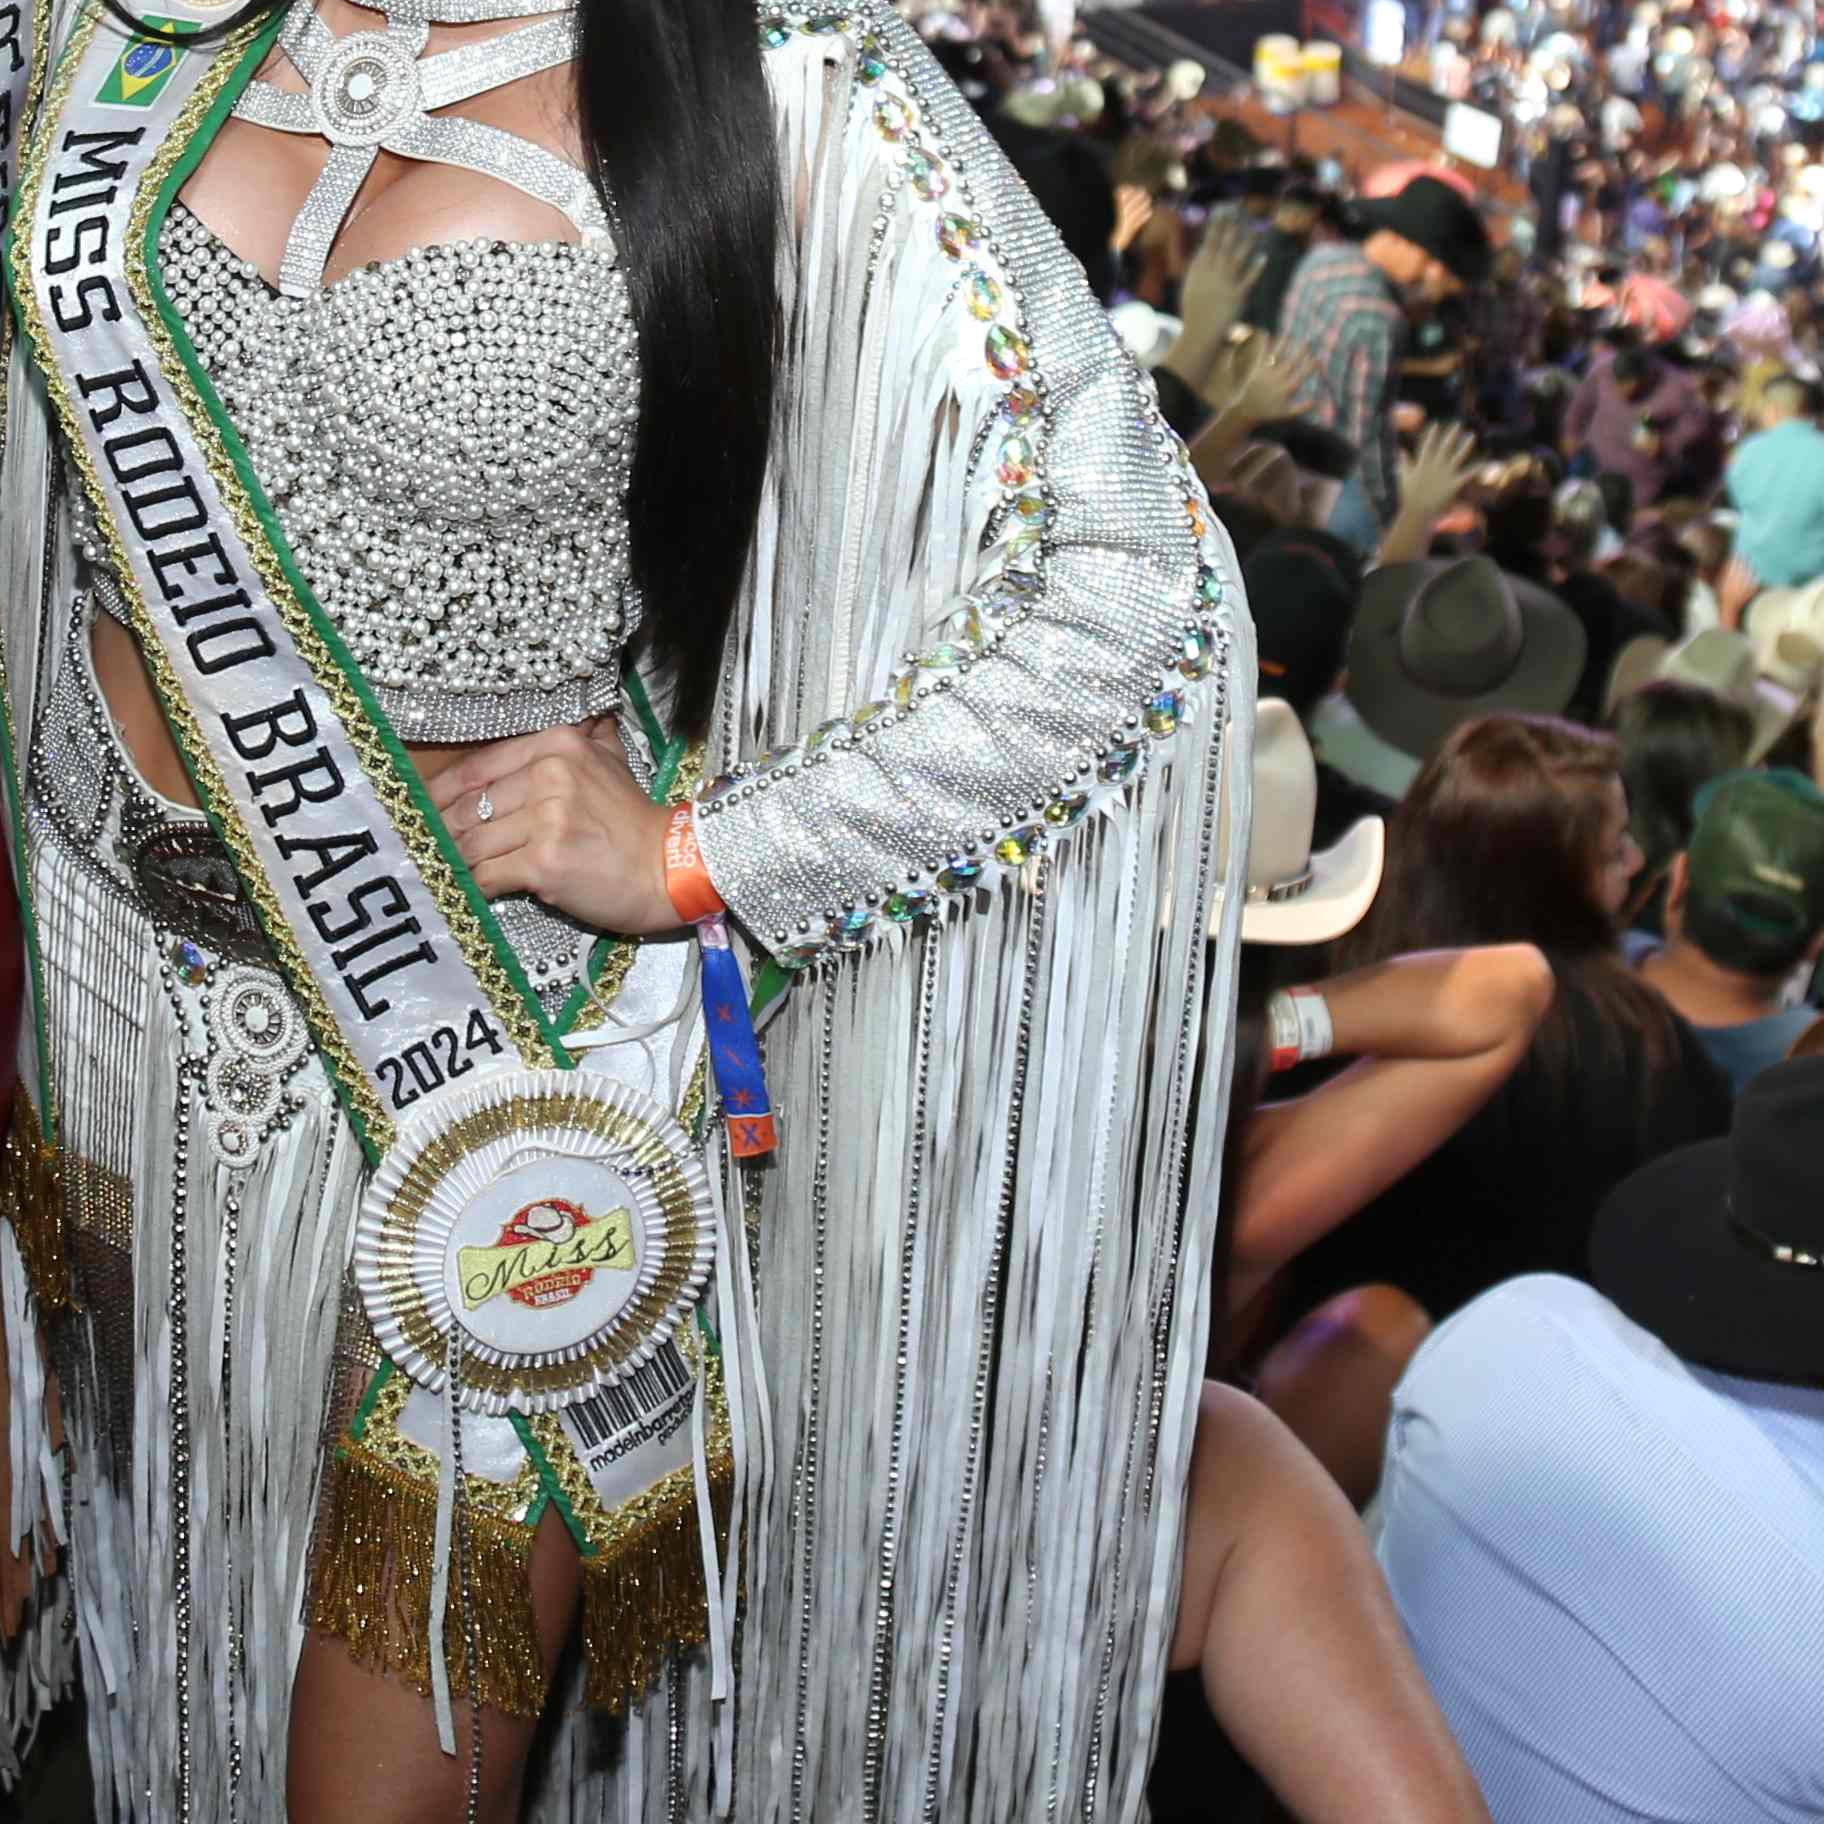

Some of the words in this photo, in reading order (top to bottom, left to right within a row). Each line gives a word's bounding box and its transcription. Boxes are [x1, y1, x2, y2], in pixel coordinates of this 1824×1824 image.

[42, 126, 147, 333] MISS
[75, 357, 276, 675] RODEIO
[220, 687, 440, 1022] BRASIL
[375, 1008, 504, 1110] 2024
[465, 1227, 631, 1301] Miss
